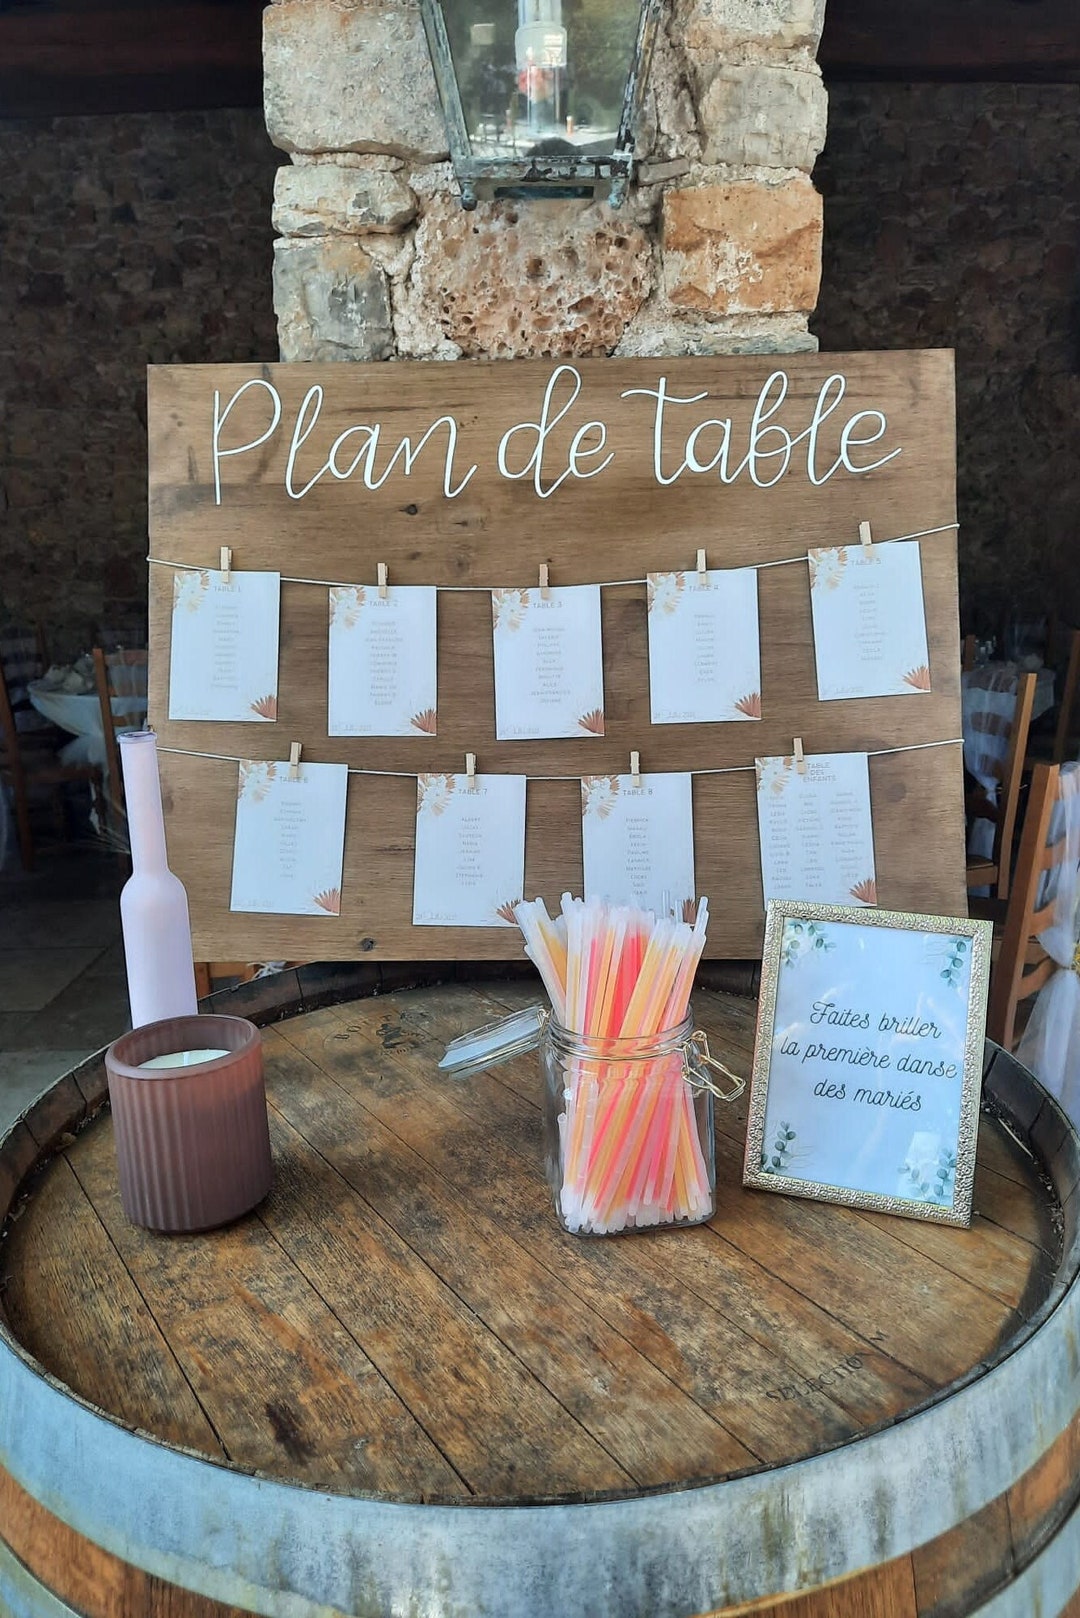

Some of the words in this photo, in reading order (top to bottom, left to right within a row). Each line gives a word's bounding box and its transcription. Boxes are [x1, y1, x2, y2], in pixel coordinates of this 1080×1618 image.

[212, 377, 479, 506] Plan
[497, 364, 614, 500] de
[621, 369, 903, 488] table
[810, 1001, 870, 1030] Faites
[878, 1012, 943, 1039] briller
[780, 1036, 800, 1056] la
[801, 1042, 891, 1071] première
[897, 1053, 958, 1079] danse
[814, 1079, 846, 1100] des
[854, 1086, 922, 1112] mariés
